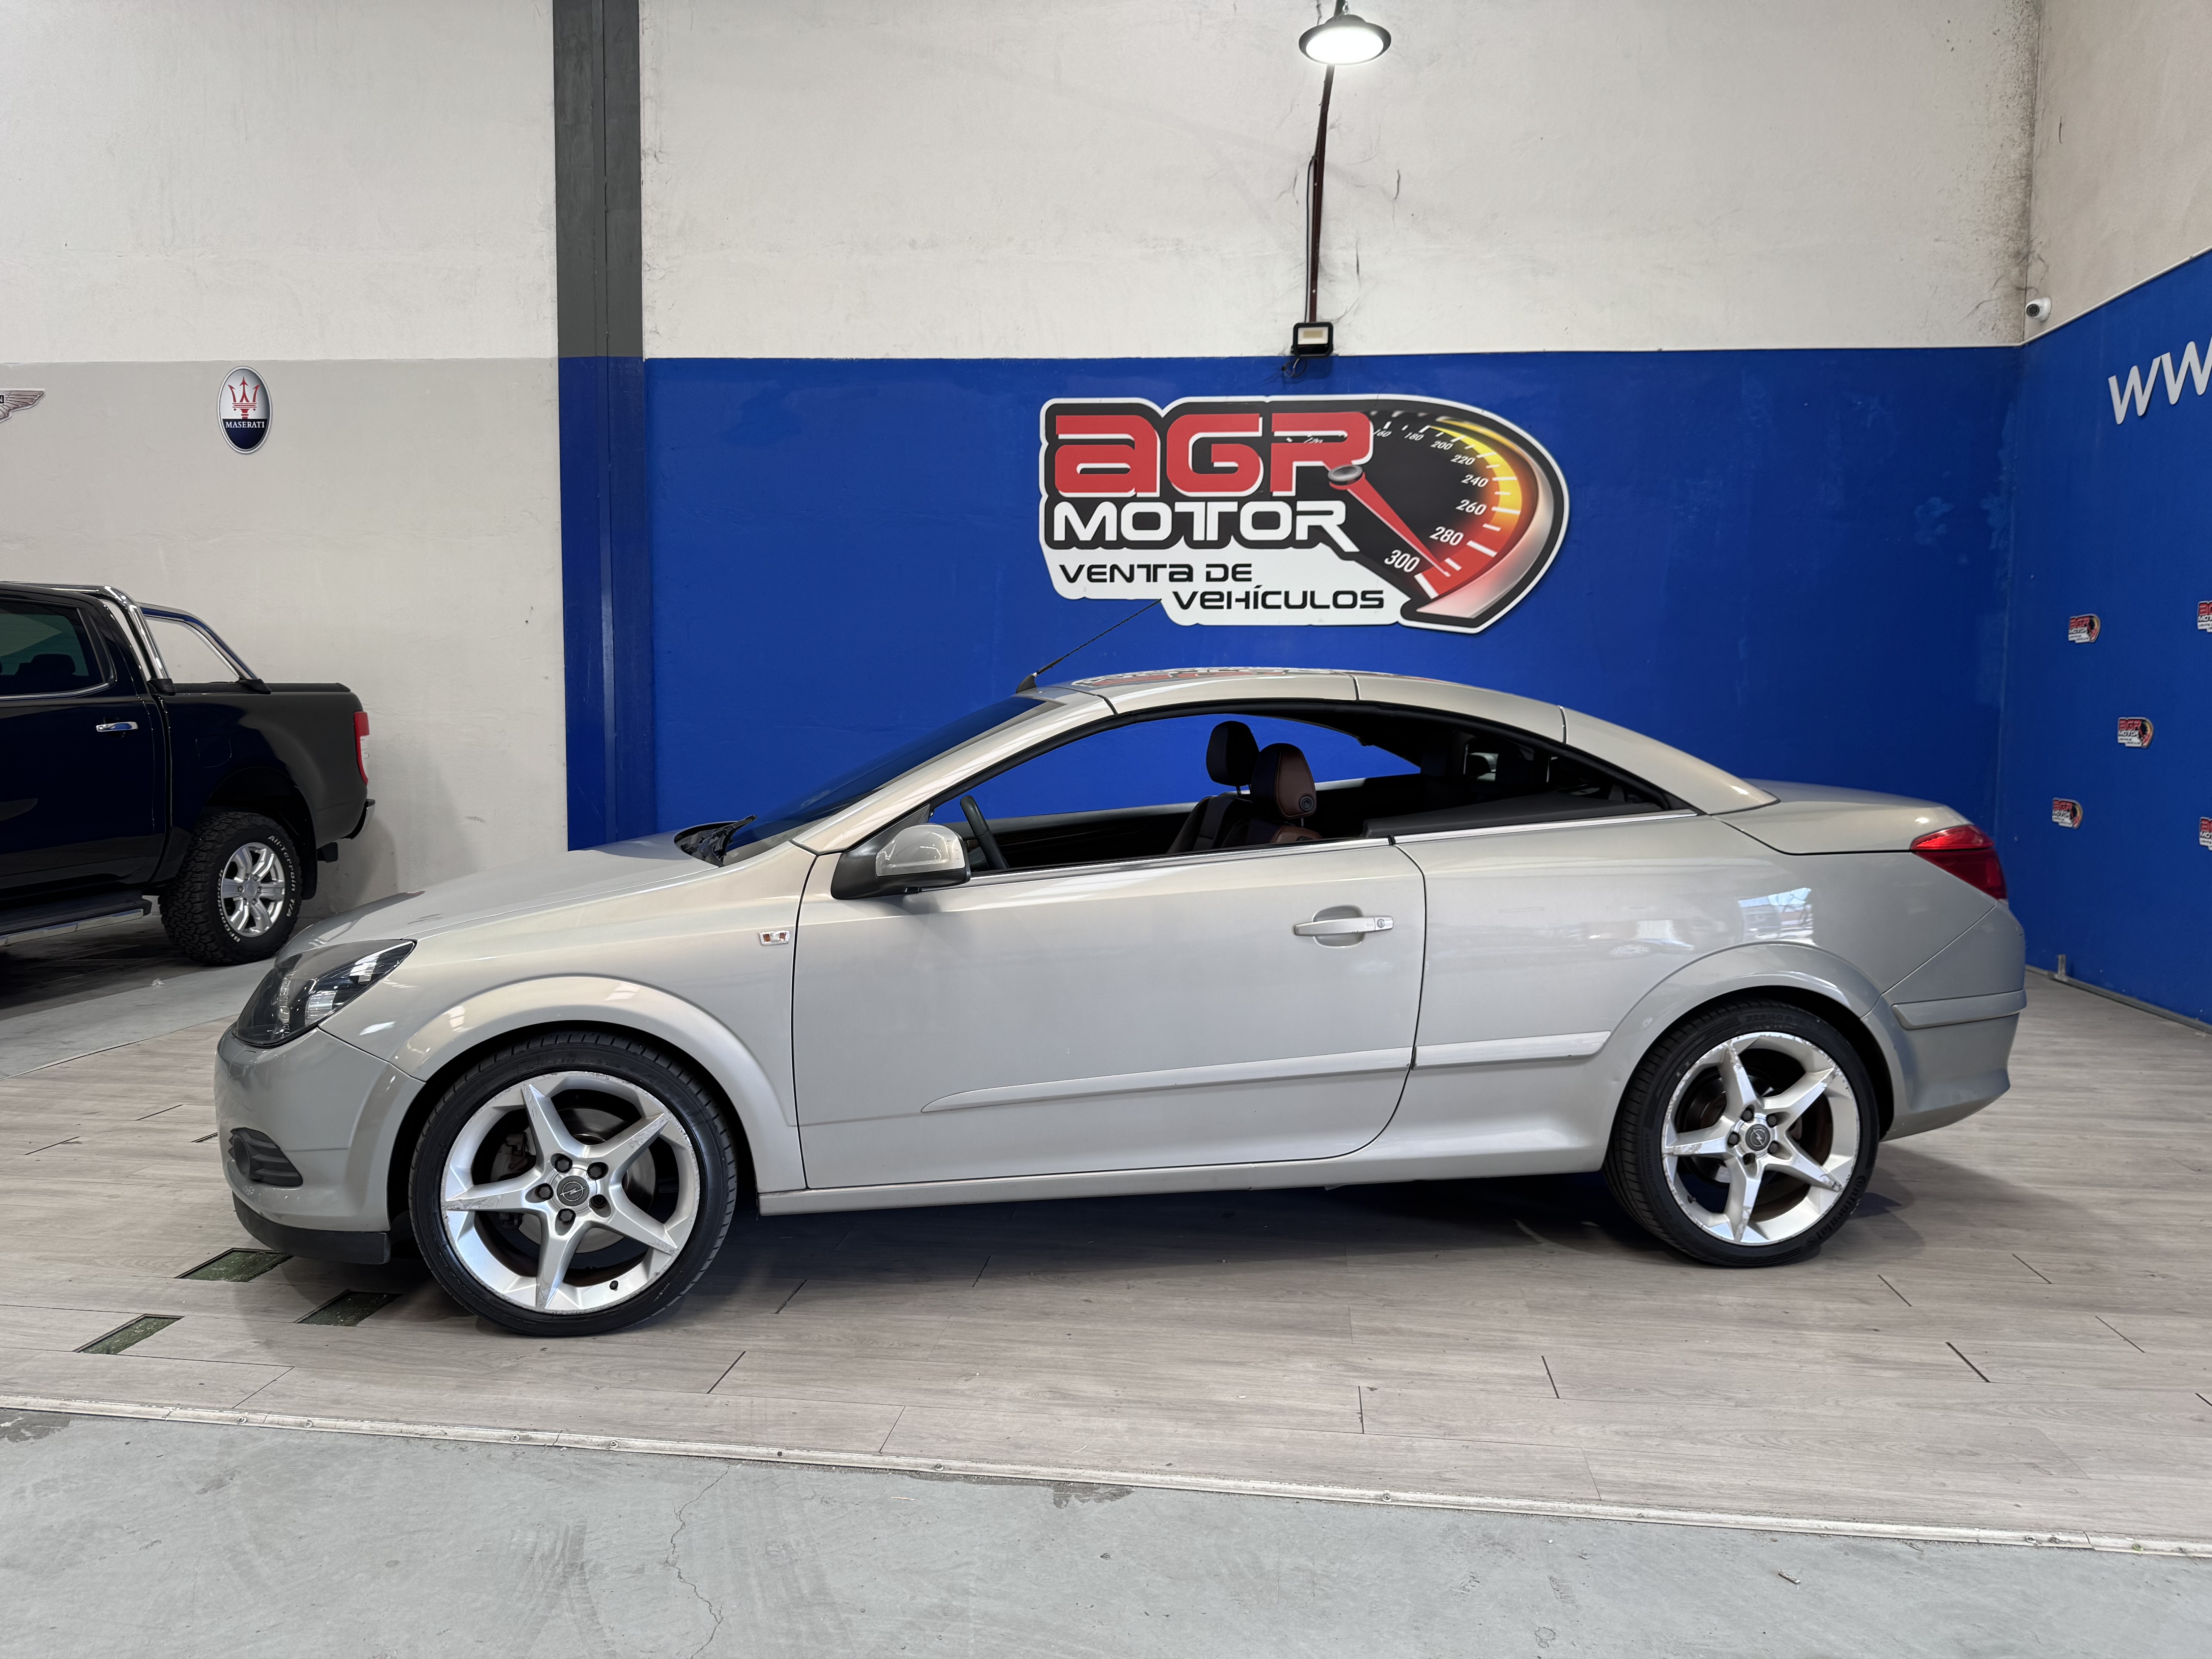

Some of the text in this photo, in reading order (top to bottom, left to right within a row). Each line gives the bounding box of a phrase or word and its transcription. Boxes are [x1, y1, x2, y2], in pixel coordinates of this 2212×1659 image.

[1404, 432, 1424, 441] 180
[1430, 440, 1453, 450] 200
[1450, 454, 1475, 465] 220
[1461, 474, 1489, 488] 240
[1456, 499, 1487, 515] 260
[1054, 501, 1360, 552] MOTOR
[1429, 526, 1464, 546] 280
[1384, 550, 1420, 573] 300
[1206, 563, 1253, 582] DE
[286, 898, 295, 917] T/A
[1816, 1175, 1866, 1240] Continental
